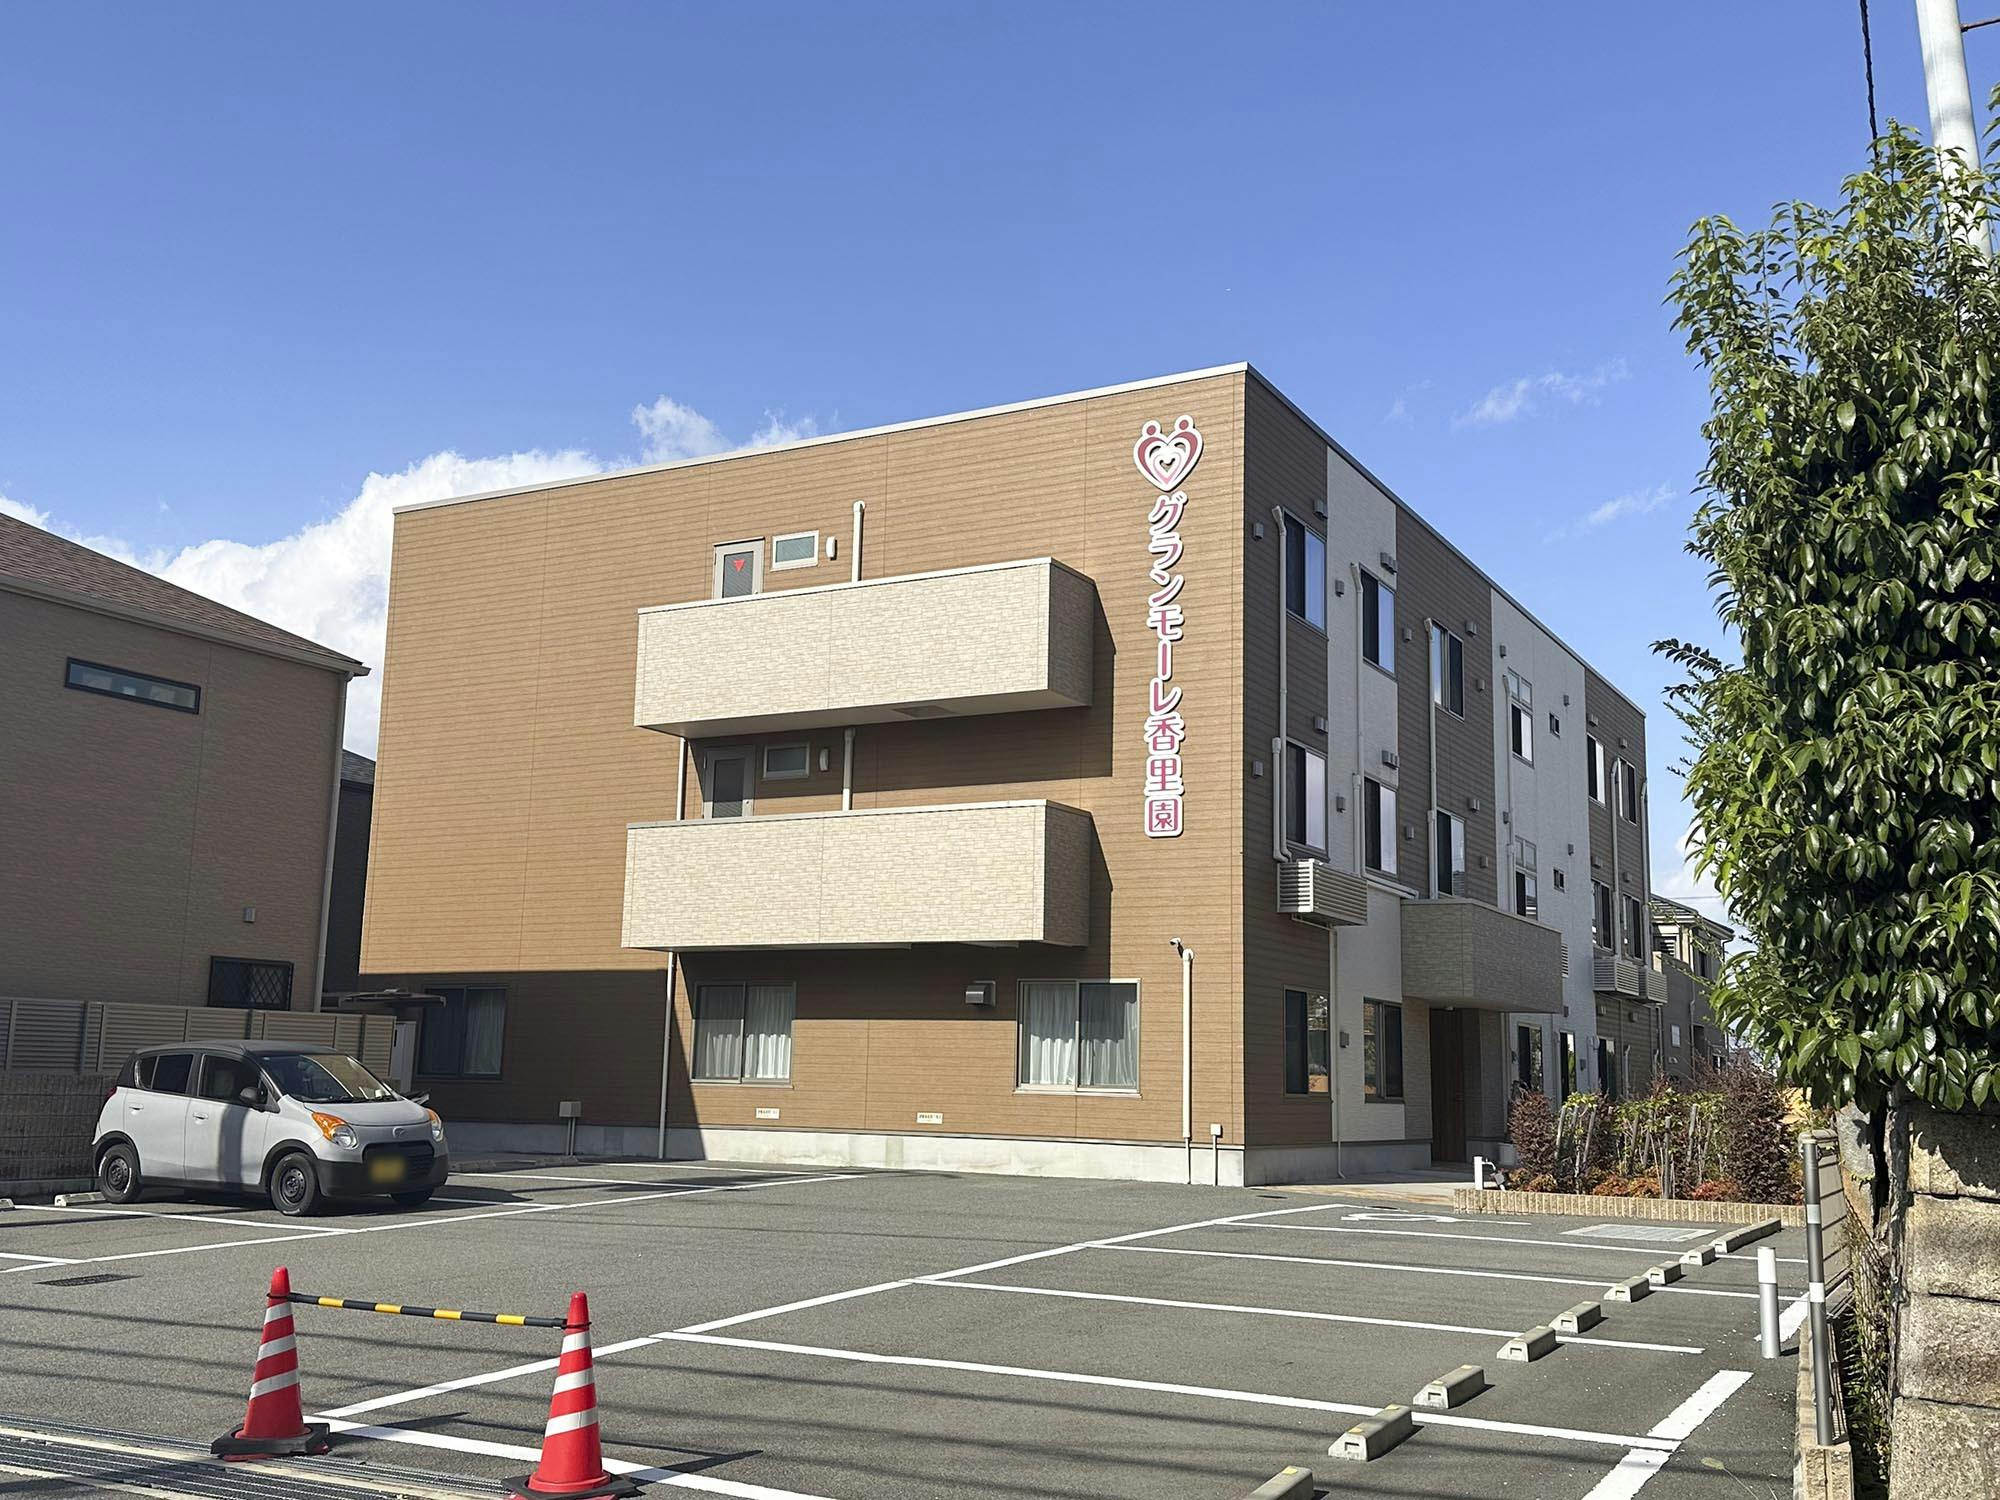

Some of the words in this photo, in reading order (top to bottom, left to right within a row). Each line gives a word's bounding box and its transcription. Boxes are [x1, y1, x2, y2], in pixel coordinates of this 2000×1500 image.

[1146, 493, 1185, 834] グランモーレ香里園
